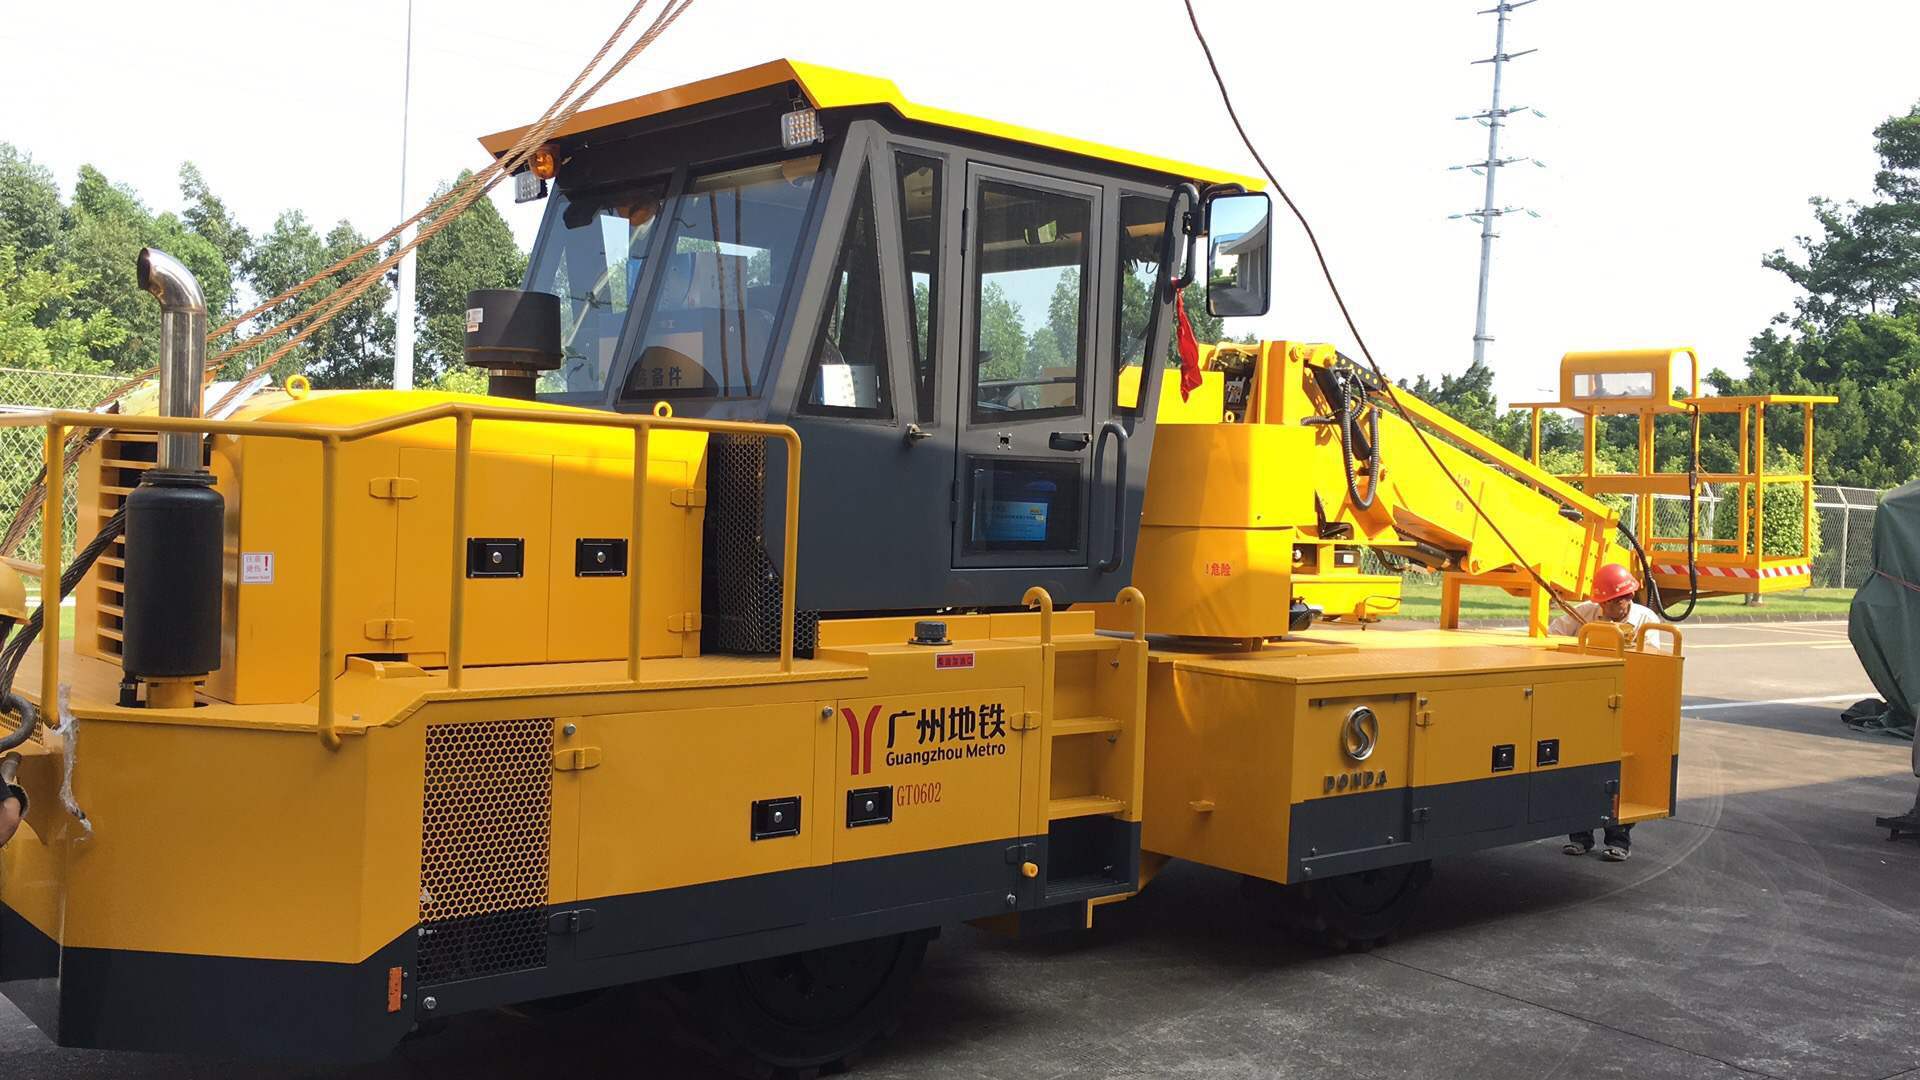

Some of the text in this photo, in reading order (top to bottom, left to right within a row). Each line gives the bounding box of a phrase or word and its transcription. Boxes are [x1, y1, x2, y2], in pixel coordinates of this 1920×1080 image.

[887, 703, 1006, 748] 广州地铁
[886, 743, 1006, 767] Guangzhou Metro
[896, 782, 942, 807] GT0602
